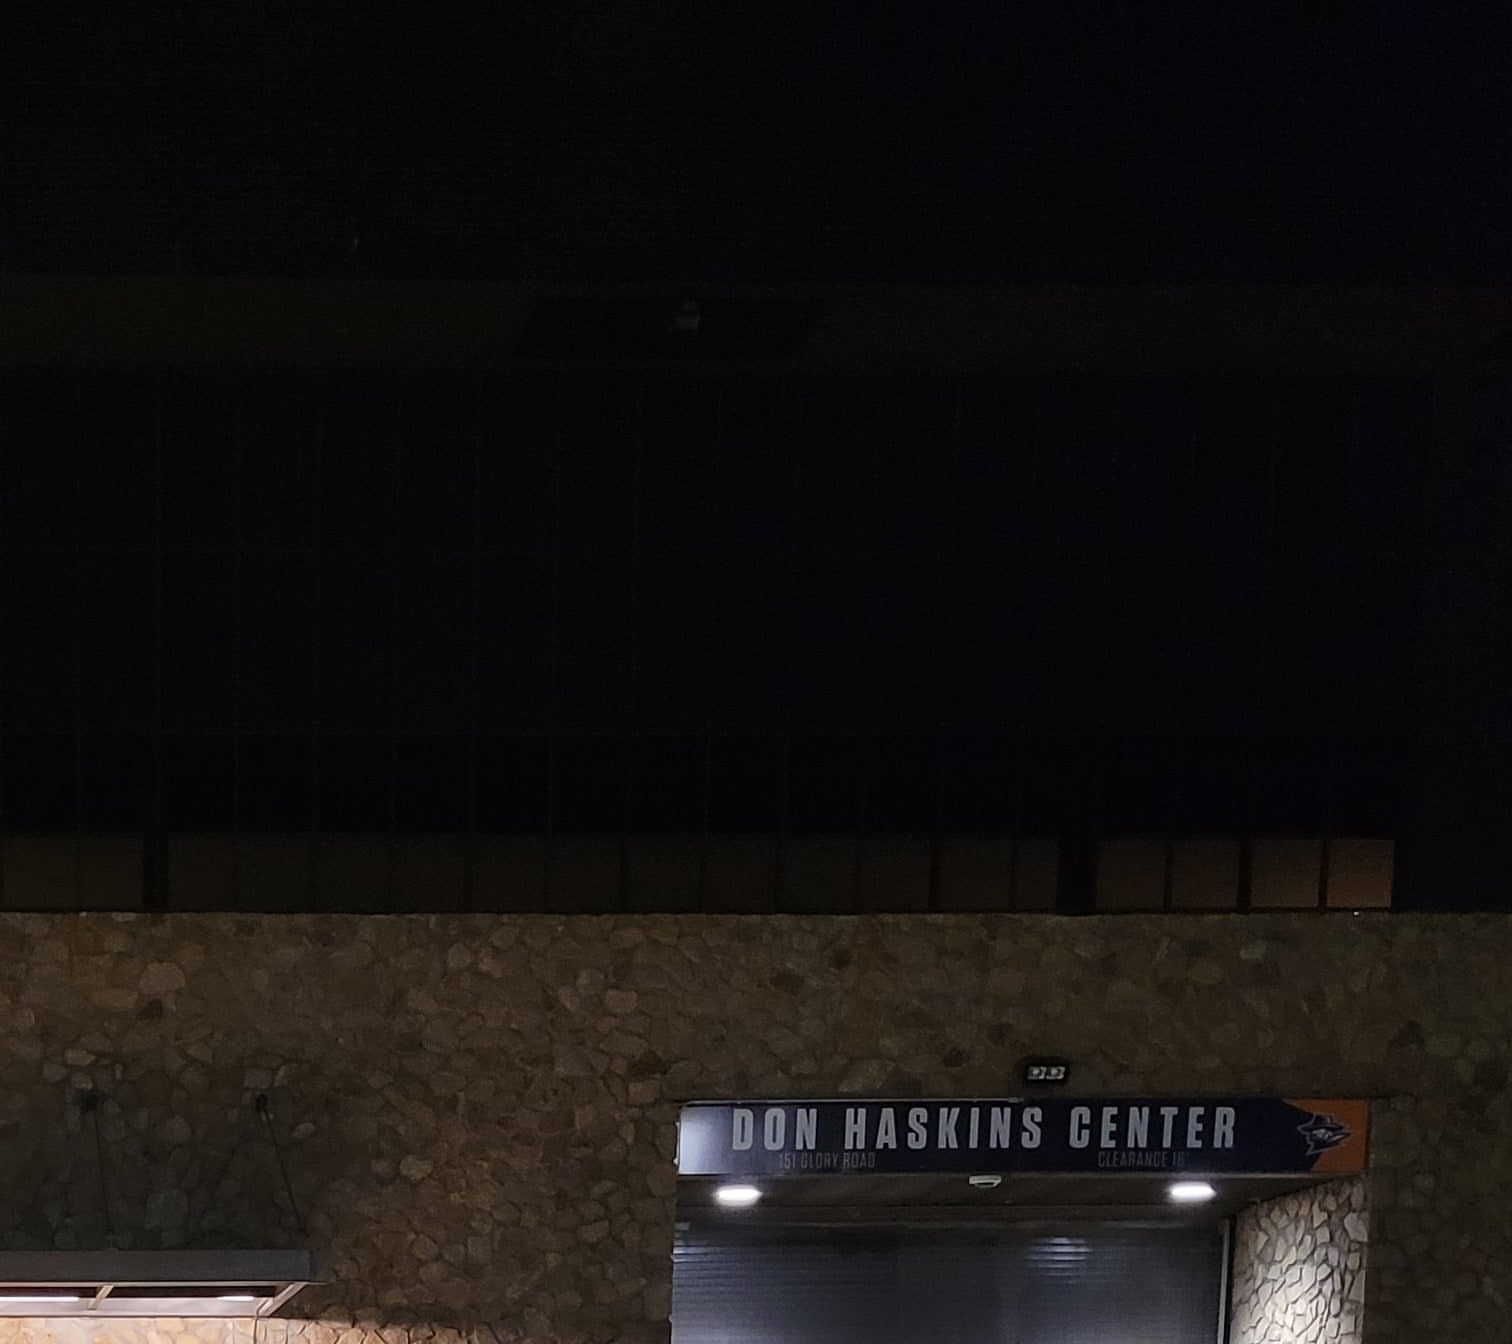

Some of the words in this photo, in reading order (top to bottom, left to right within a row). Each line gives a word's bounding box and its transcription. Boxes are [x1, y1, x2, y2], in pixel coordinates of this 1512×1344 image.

[732, 1107, 818, 1151] DON
[843, 1106, 1046, 1150] HASKINS
[1068, 1105, 1236, 1150] CENTER
[778, 1151, 797, 1169] 151
[800, 1151, 838, 1169] GLORY
[842, 1151, 877, 1169] ROAD
[1097, 1150, 1169, 1168] CLEARANCE
